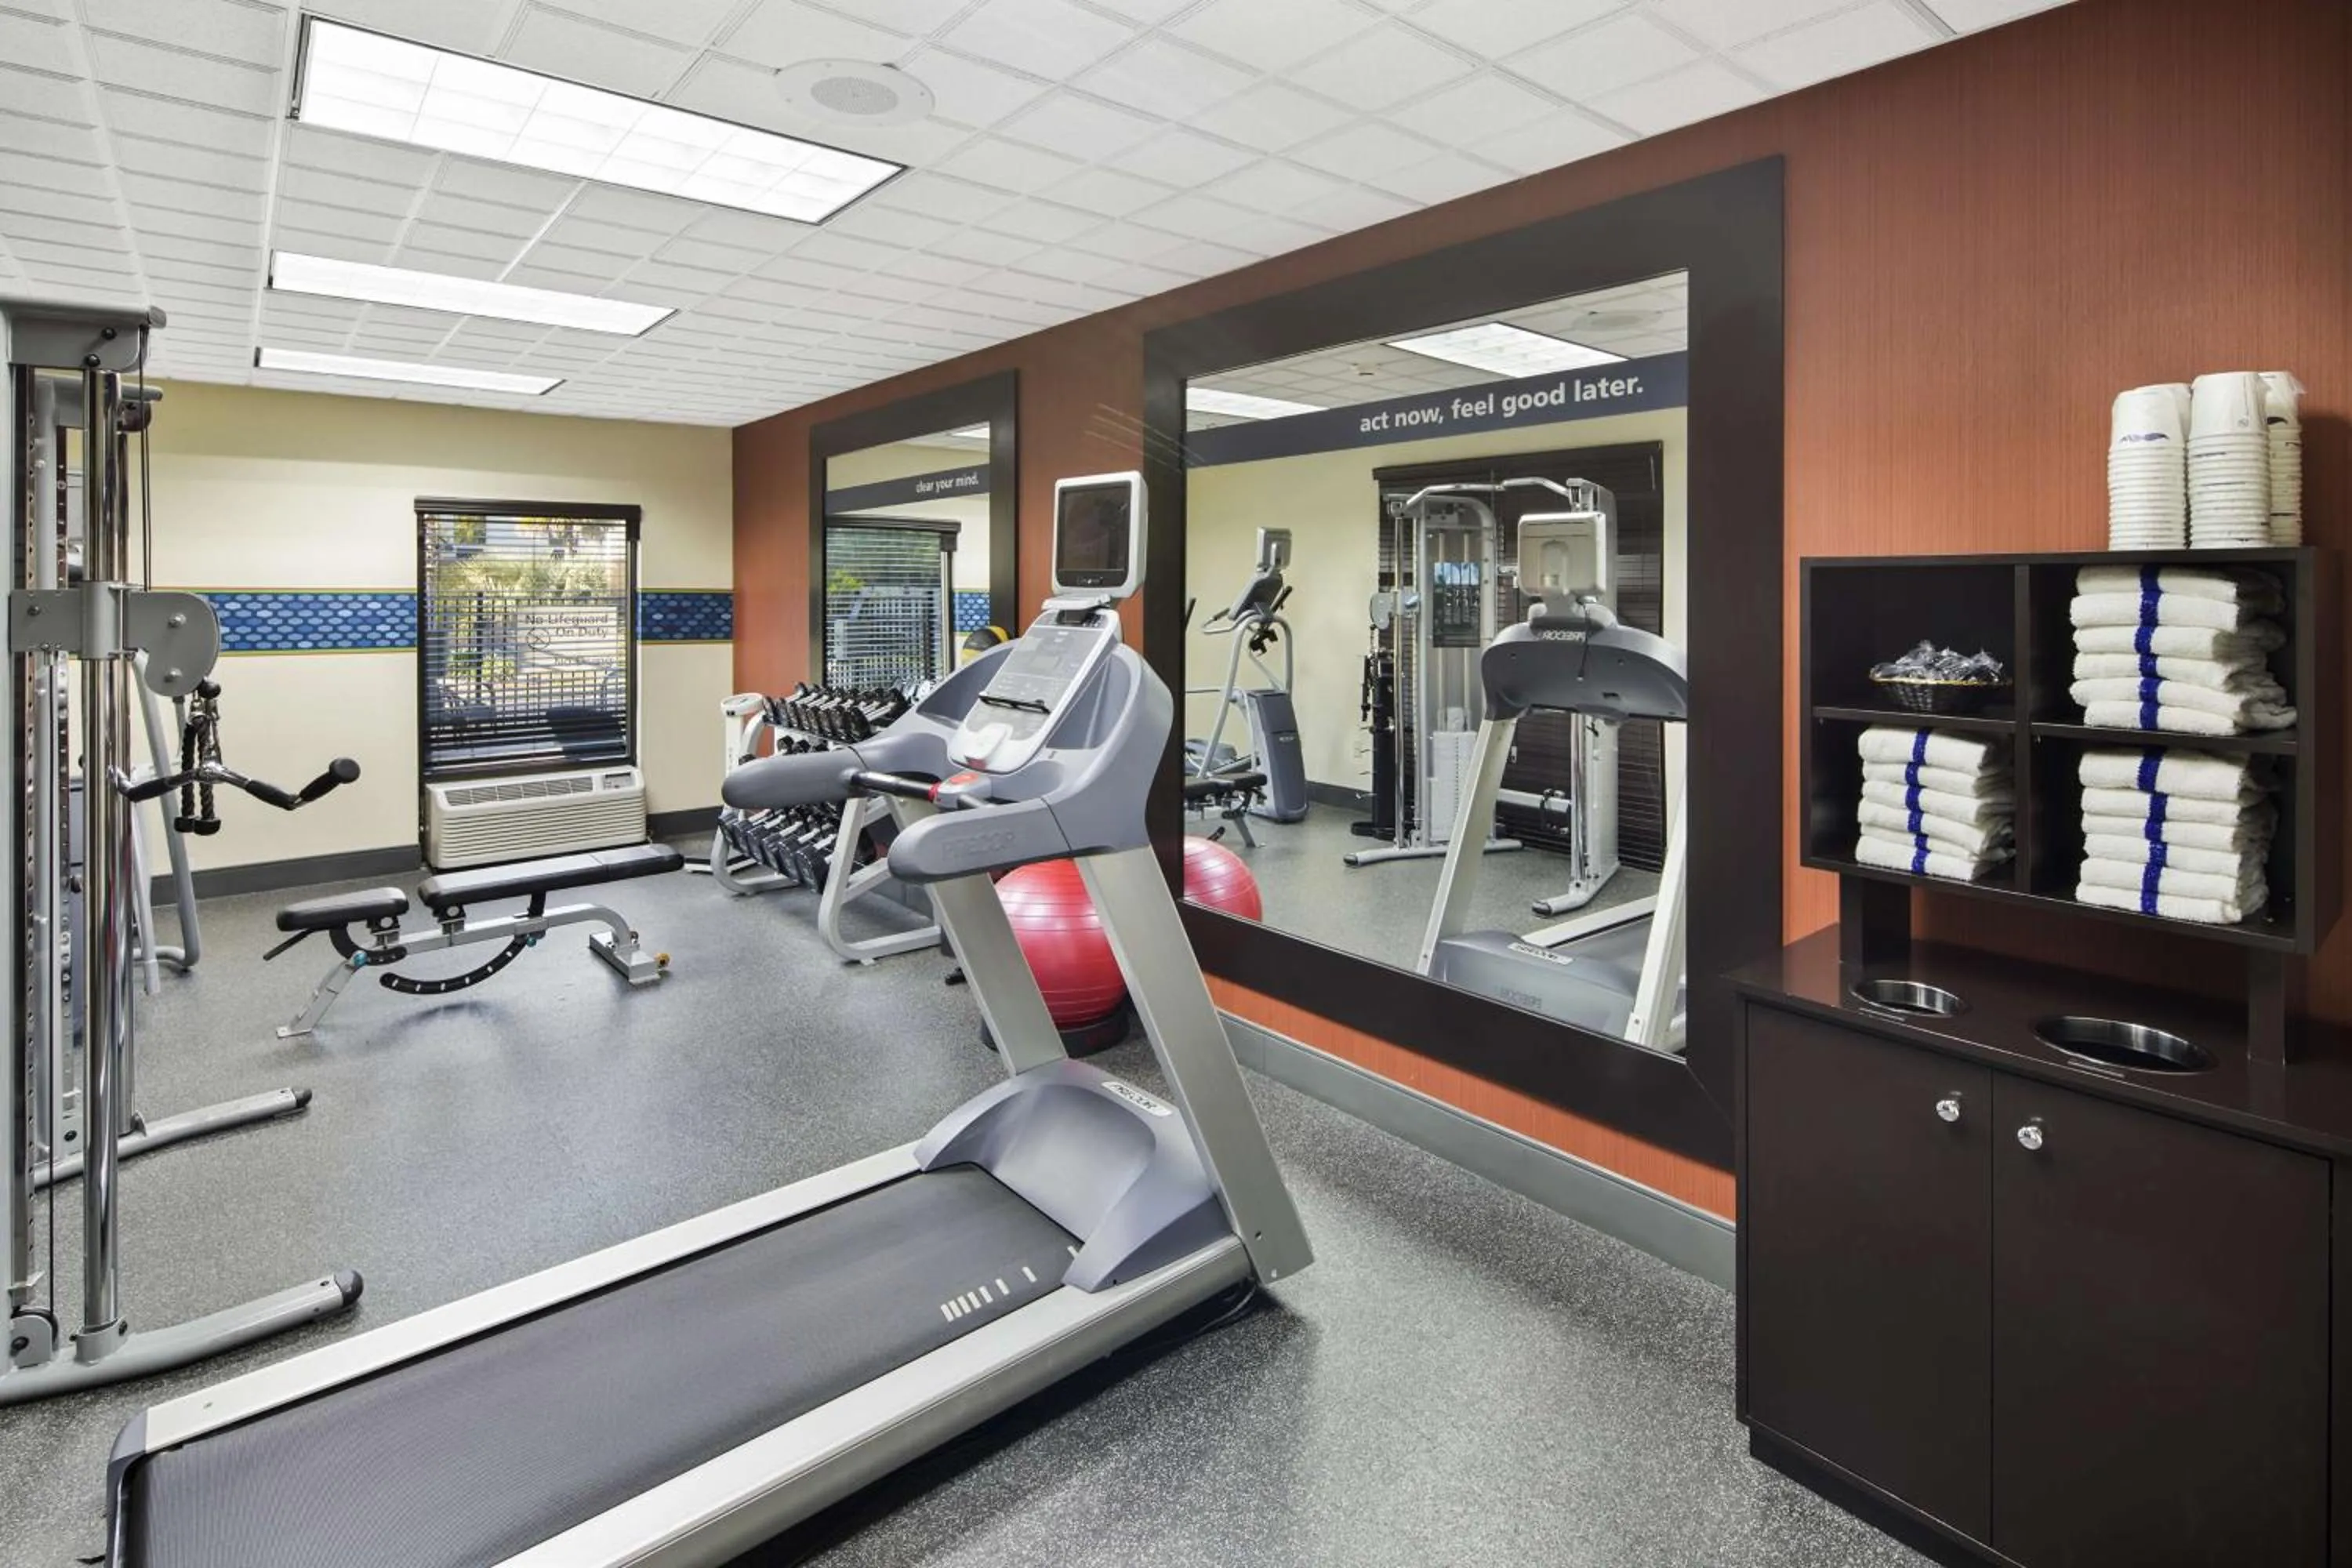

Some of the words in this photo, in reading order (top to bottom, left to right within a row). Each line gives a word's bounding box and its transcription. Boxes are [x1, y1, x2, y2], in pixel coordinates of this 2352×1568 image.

[1360, 412, 1389, 432] act
[1395, 407, 1444, 426] now,
[1451, 394, 1494, 419] feel
[1502, 382, 1566, 417] good
[1574, 376, 1643, 402] later.
[916, 479, 934, 493] clear
[935, 478, 954, 493] your
[956, 471, 979, 487] mind.
